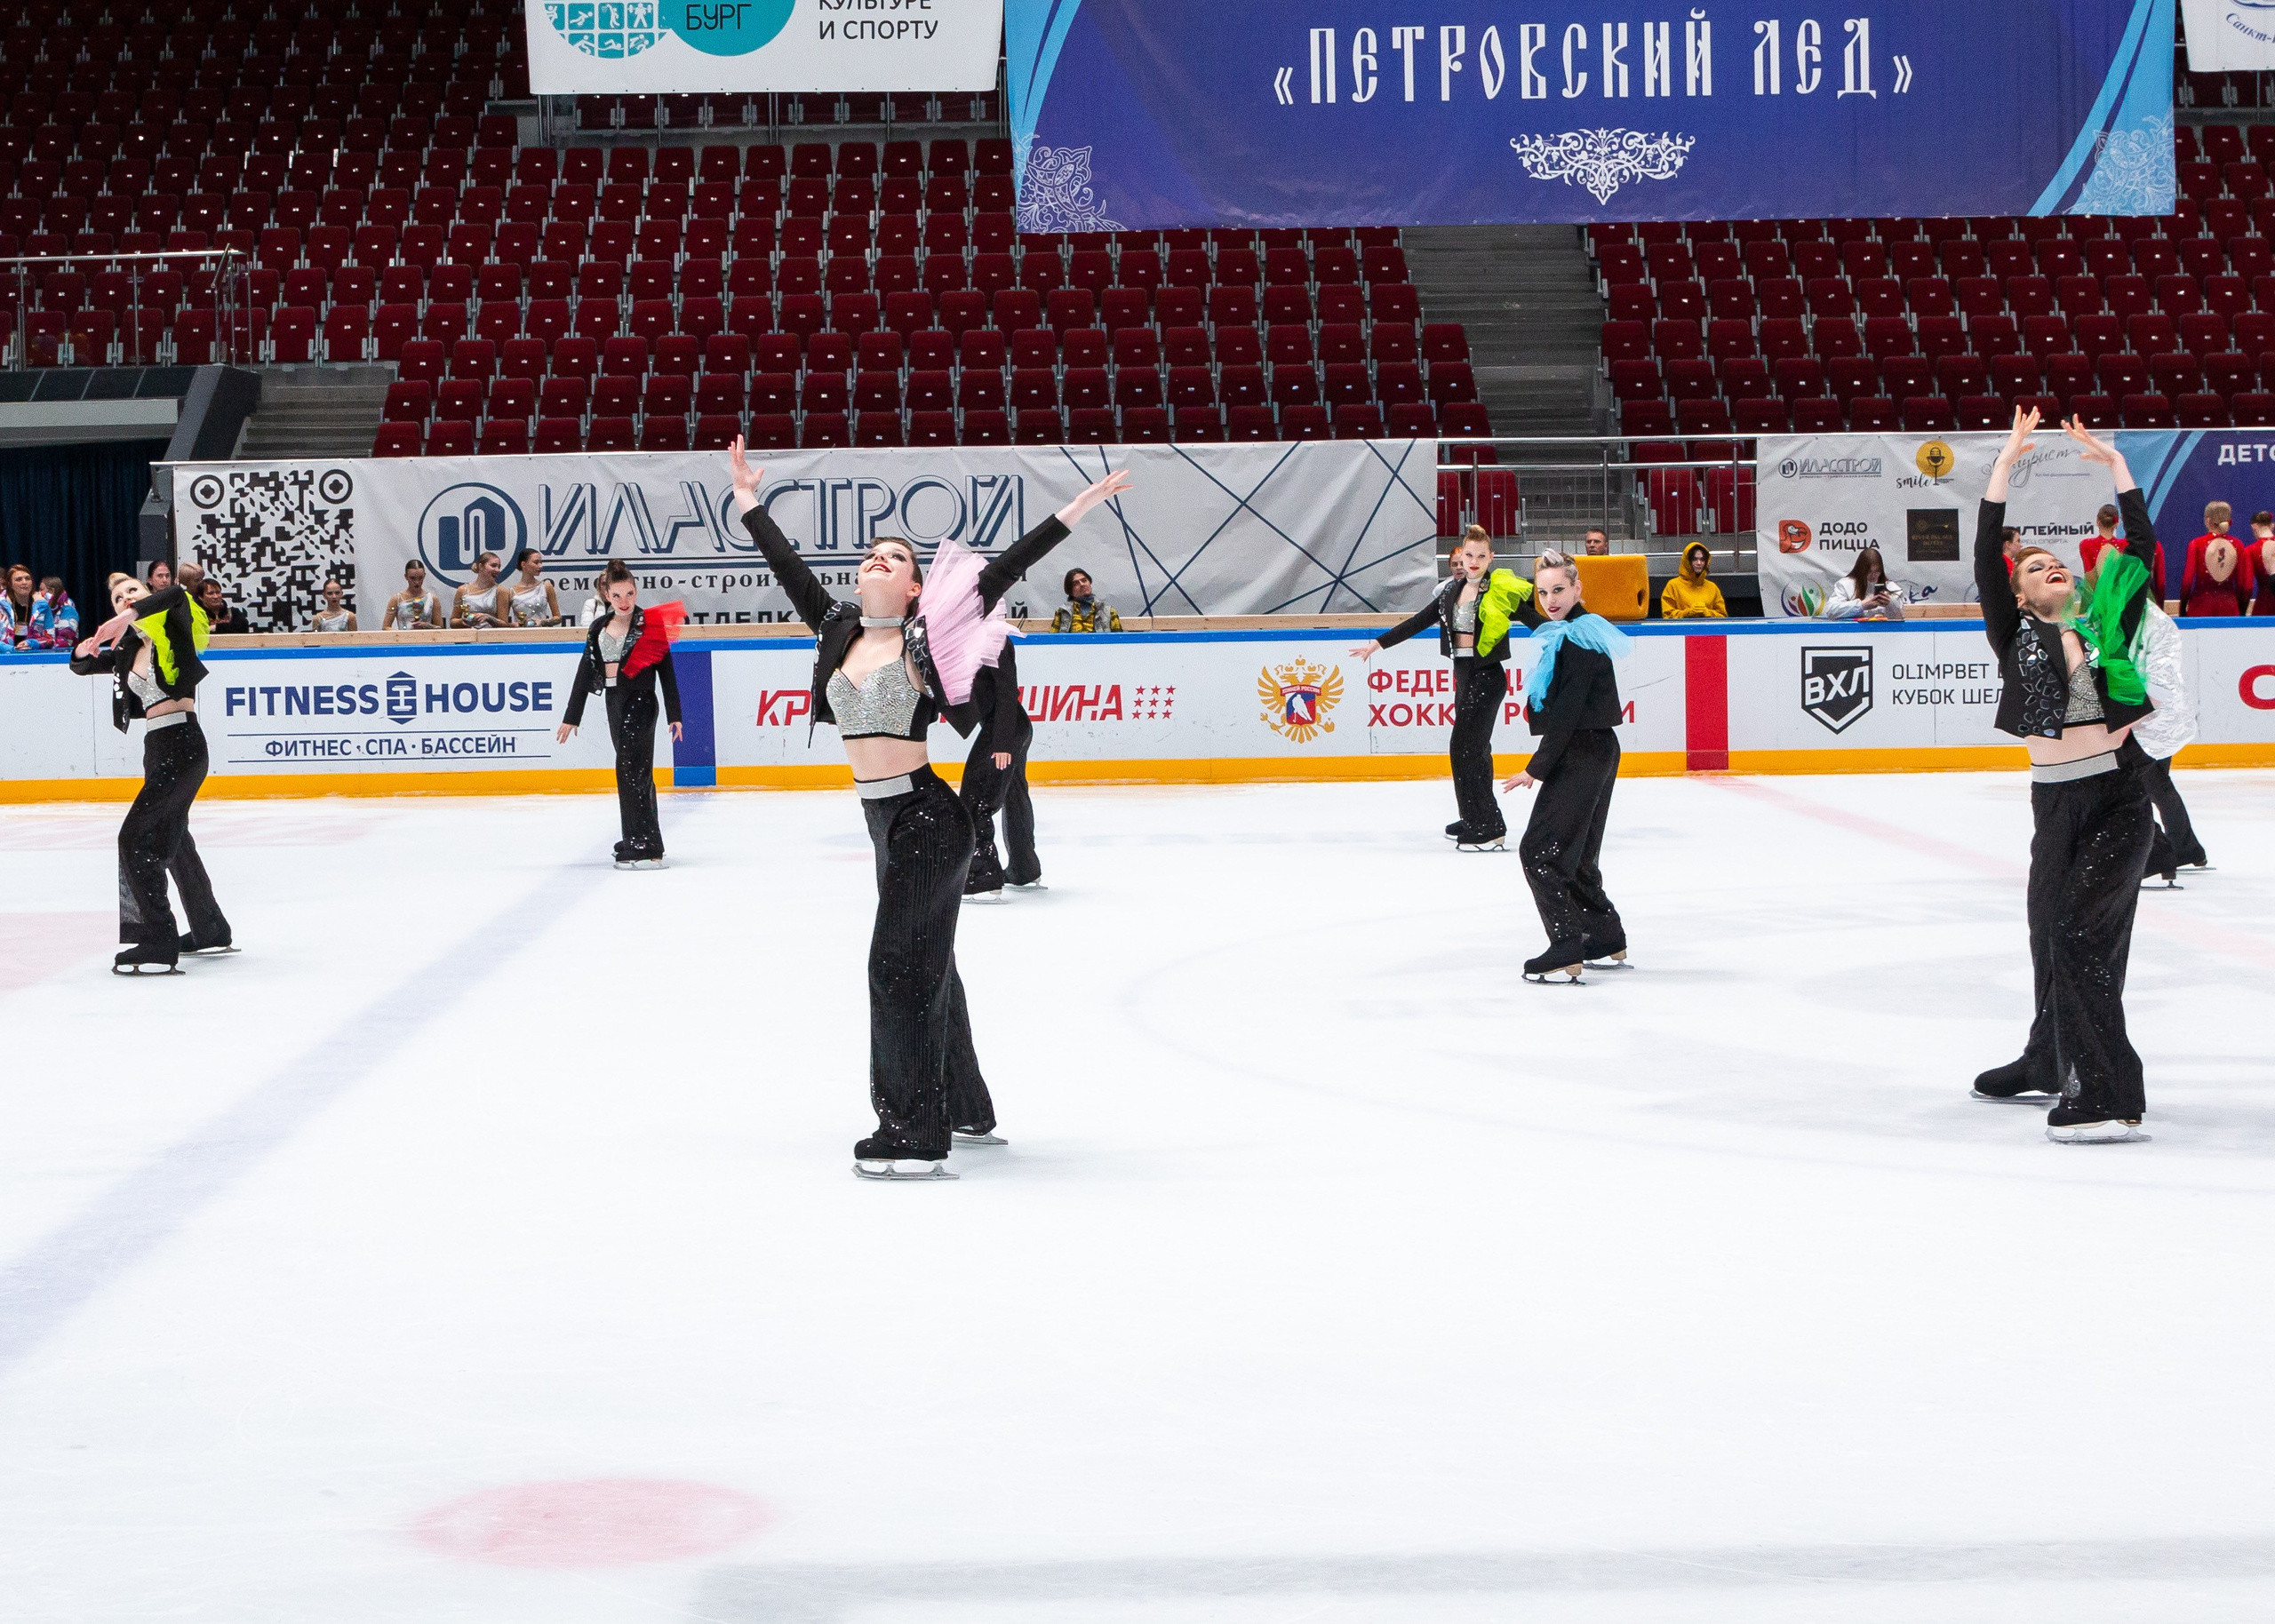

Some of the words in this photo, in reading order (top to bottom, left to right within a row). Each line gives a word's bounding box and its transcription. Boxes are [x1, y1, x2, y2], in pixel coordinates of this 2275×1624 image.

[685, 4, 753, 30] БУРГ
[819, 20, 835, 40] И
[842, 20, 938, 40] СПОРТУ
[1273, 7, 1712, 105] «ПЕТРОВСКИЙ
[1752, 18, 1912, 100] ЛЕД»
[1896, 472, 1930, 489] smile
[1819, 521, 1868, 536] ДОДО
[1818, 537, 1880, 552] ПИЦЦА
[1892, 663, 1990, 680] OLIMPBET
[1805, 665, 1870, 706] ВХЛ
[225, 684, 380, 717] FITNESS
[425, 681, 553, 713] HOUSE
[1892, 689, 1955, 705] КУБОК
[266, 738, 352, 757] ФИТНЕС
[365, 738, 408, 755] СПА
[421, 734, 515, 755] БАССЕЙН
